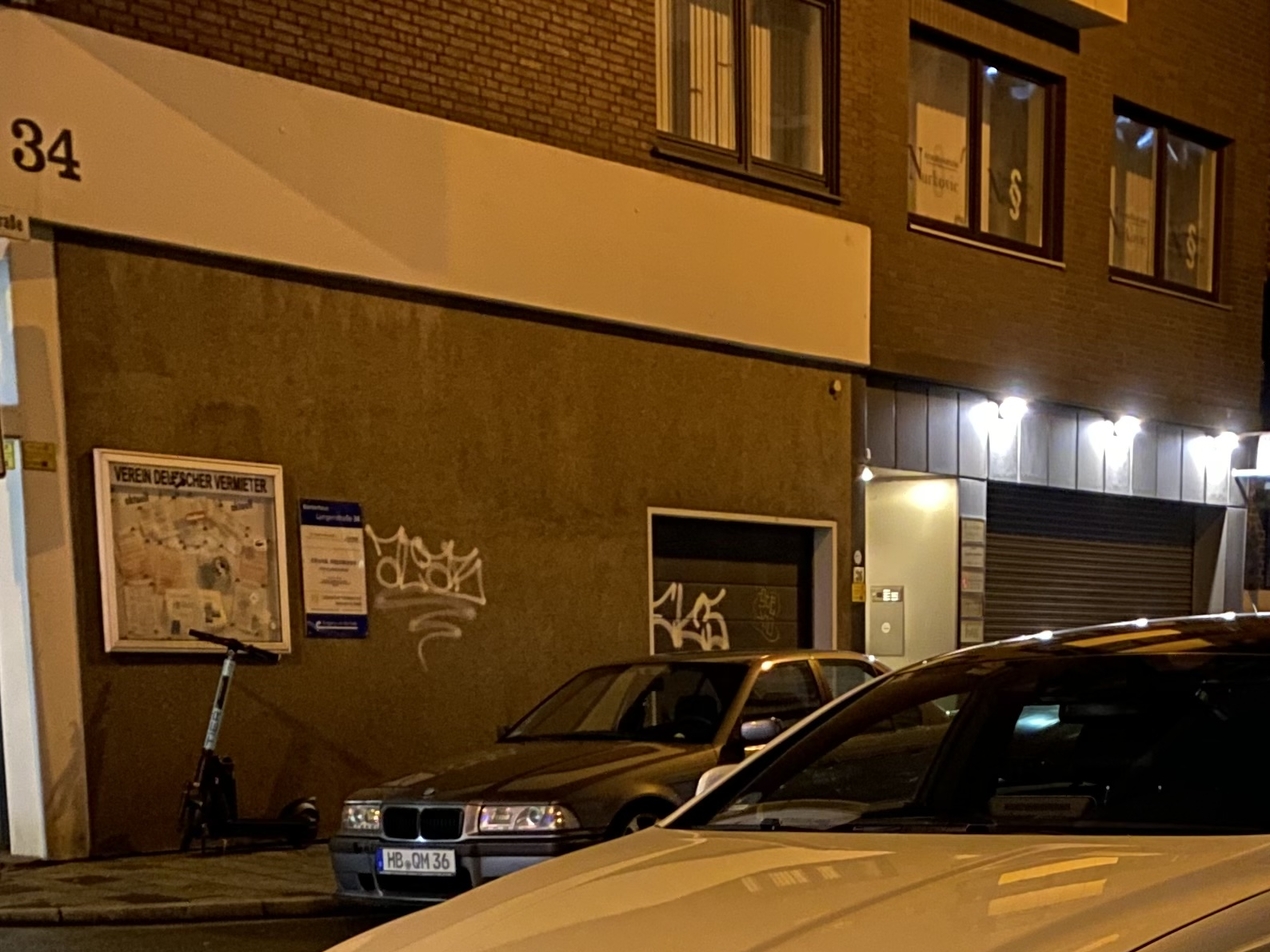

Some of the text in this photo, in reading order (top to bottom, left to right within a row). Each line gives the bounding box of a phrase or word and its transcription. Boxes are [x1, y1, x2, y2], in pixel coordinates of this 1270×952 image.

[11, 117, 82, 182] 34
[113, 466, 153, 484] VEREIN
[214, 475, 268, 494] VERMIETER
[387, 852, 450, 869] HB QM 36
